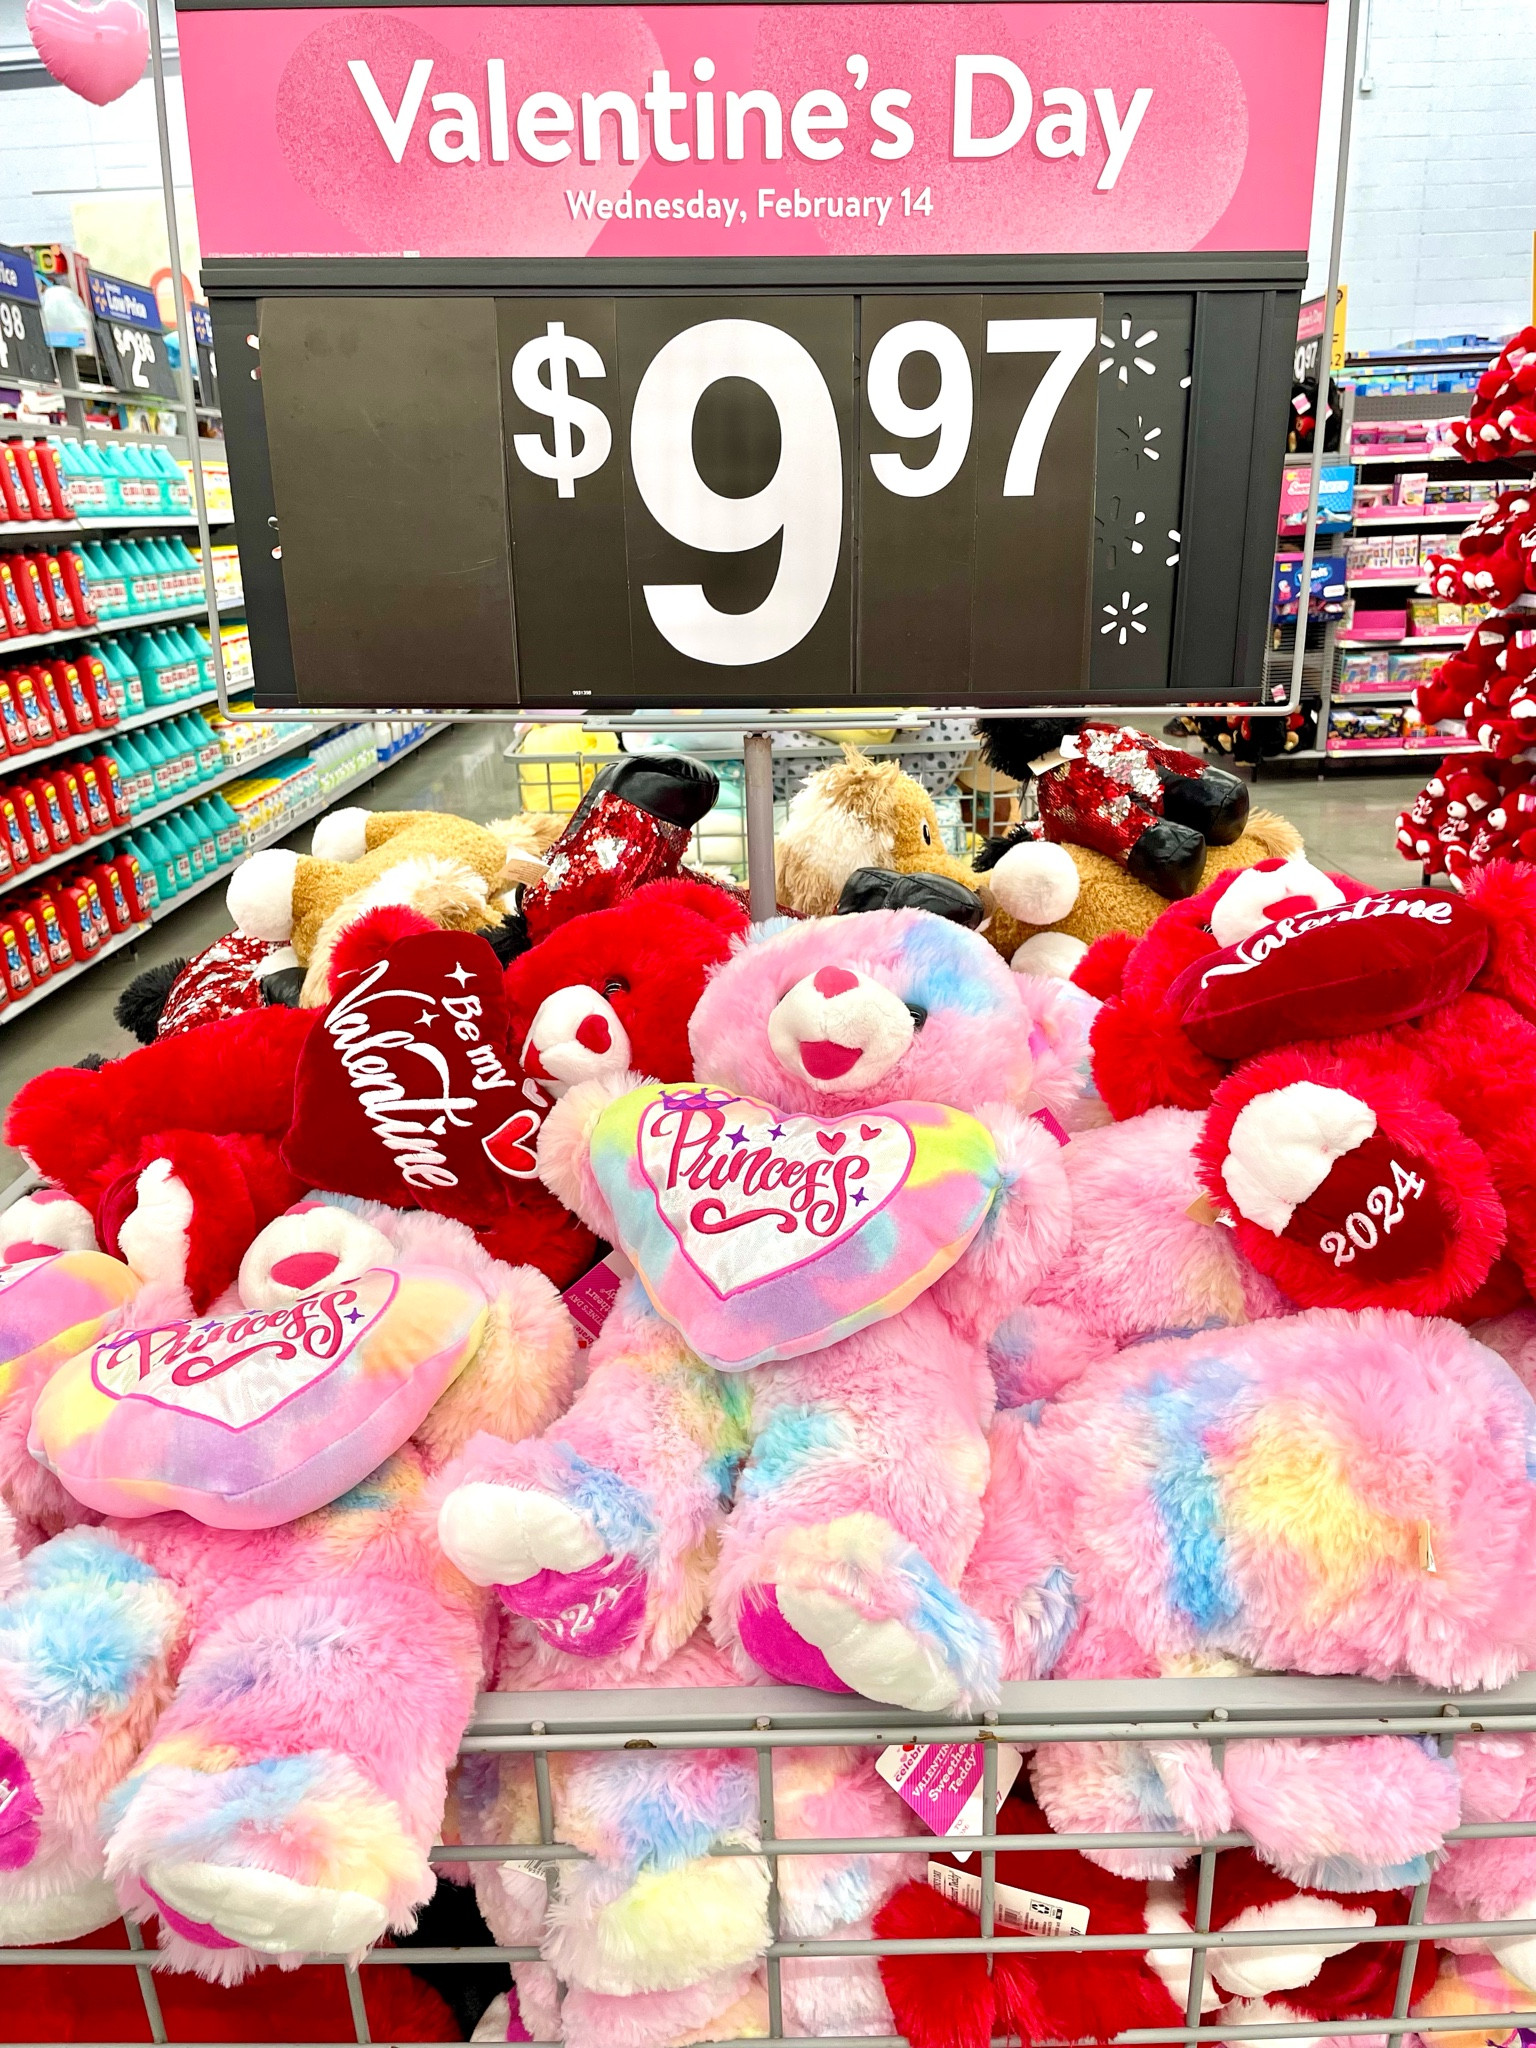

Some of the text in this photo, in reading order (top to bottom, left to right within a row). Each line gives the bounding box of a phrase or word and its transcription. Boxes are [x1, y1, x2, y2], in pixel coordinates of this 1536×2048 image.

[347, 53, 1155, 191] Valentine's Day
[565, 186, 934, 227] Wednesday, February 14
[1200, 892, 1454, 990] Valentine
[323, 959, 479, 1190] Valentine
[441, 994, 517, 1091] Be my
[649, 1107, 871, 1239] Princess
[1319, 1158, 1427, 1268] 2024
[105, 1289, 359, 1387] Princess
[911, 1743, 957, 1798] VALENTIN
